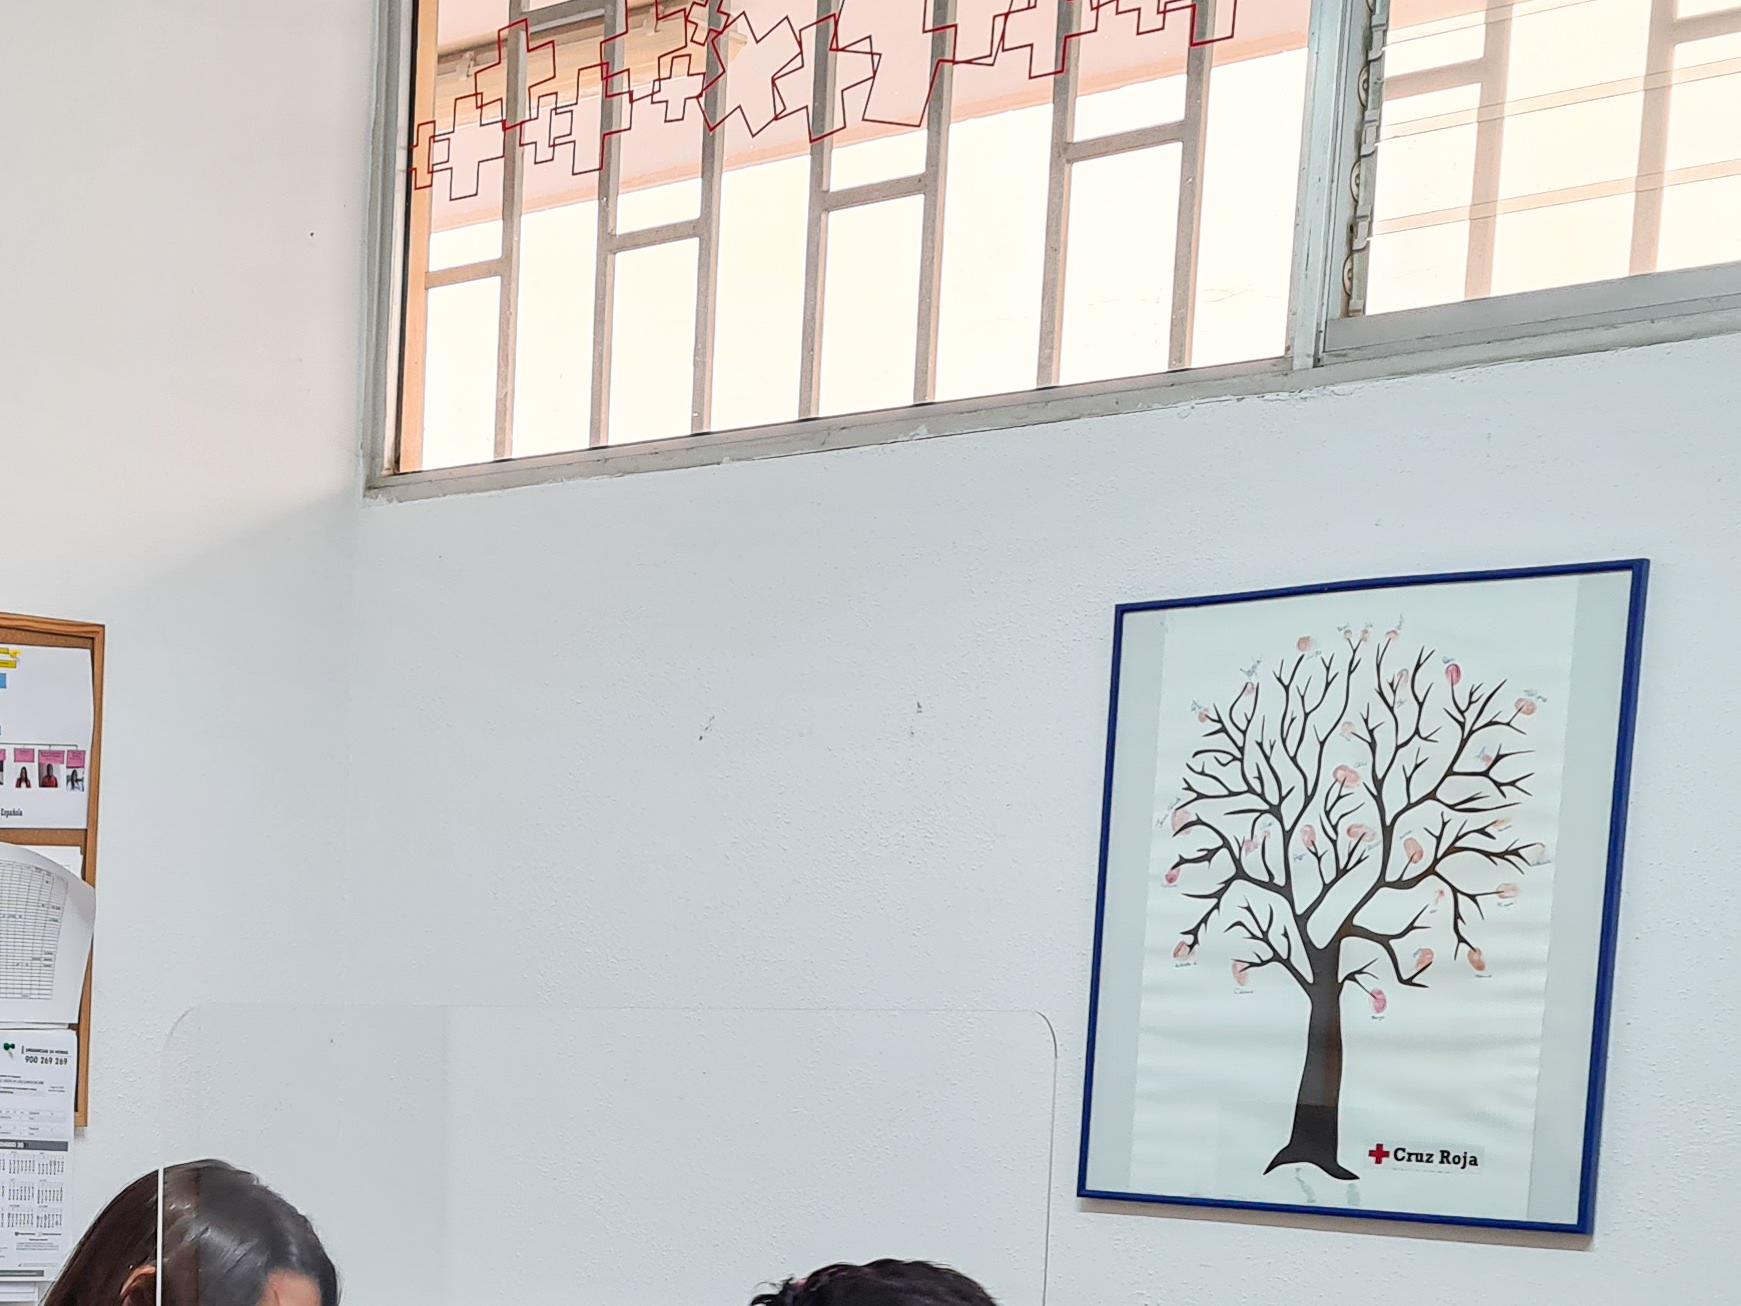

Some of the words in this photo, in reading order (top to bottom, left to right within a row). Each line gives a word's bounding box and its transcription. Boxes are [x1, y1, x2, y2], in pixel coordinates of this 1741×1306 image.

[0, 809, 23, 818] Española
[25, 1055, 38, 1064] 900
[40, 1056, 53, 1065] 269
[54, 1057, 68, 1066] 269
[1392, 1146, 1436, 1165] Cruz
[1438, 1148, 1479, 1167] Roja
